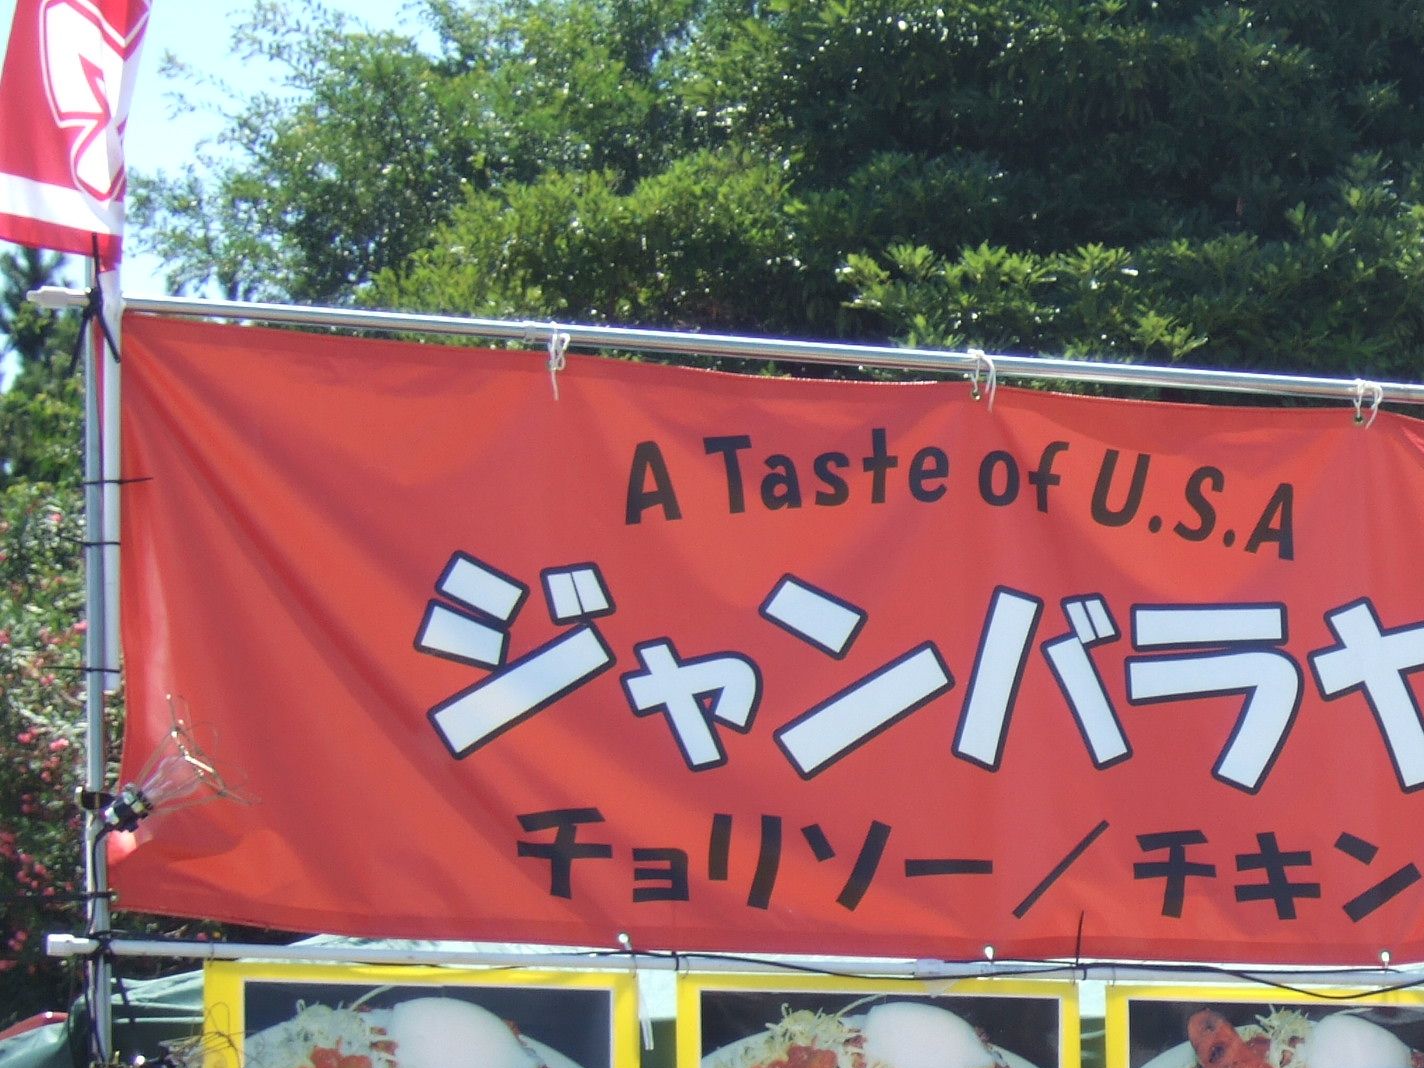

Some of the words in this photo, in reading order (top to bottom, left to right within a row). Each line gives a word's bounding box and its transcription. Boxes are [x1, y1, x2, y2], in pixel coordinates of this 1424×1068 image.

[625, 441, 682, 525] A
[703, 428, 950, 514] Taste
[978, 441, 1070, 513] of
[1090, 449, 1295, 561] U.S.A
